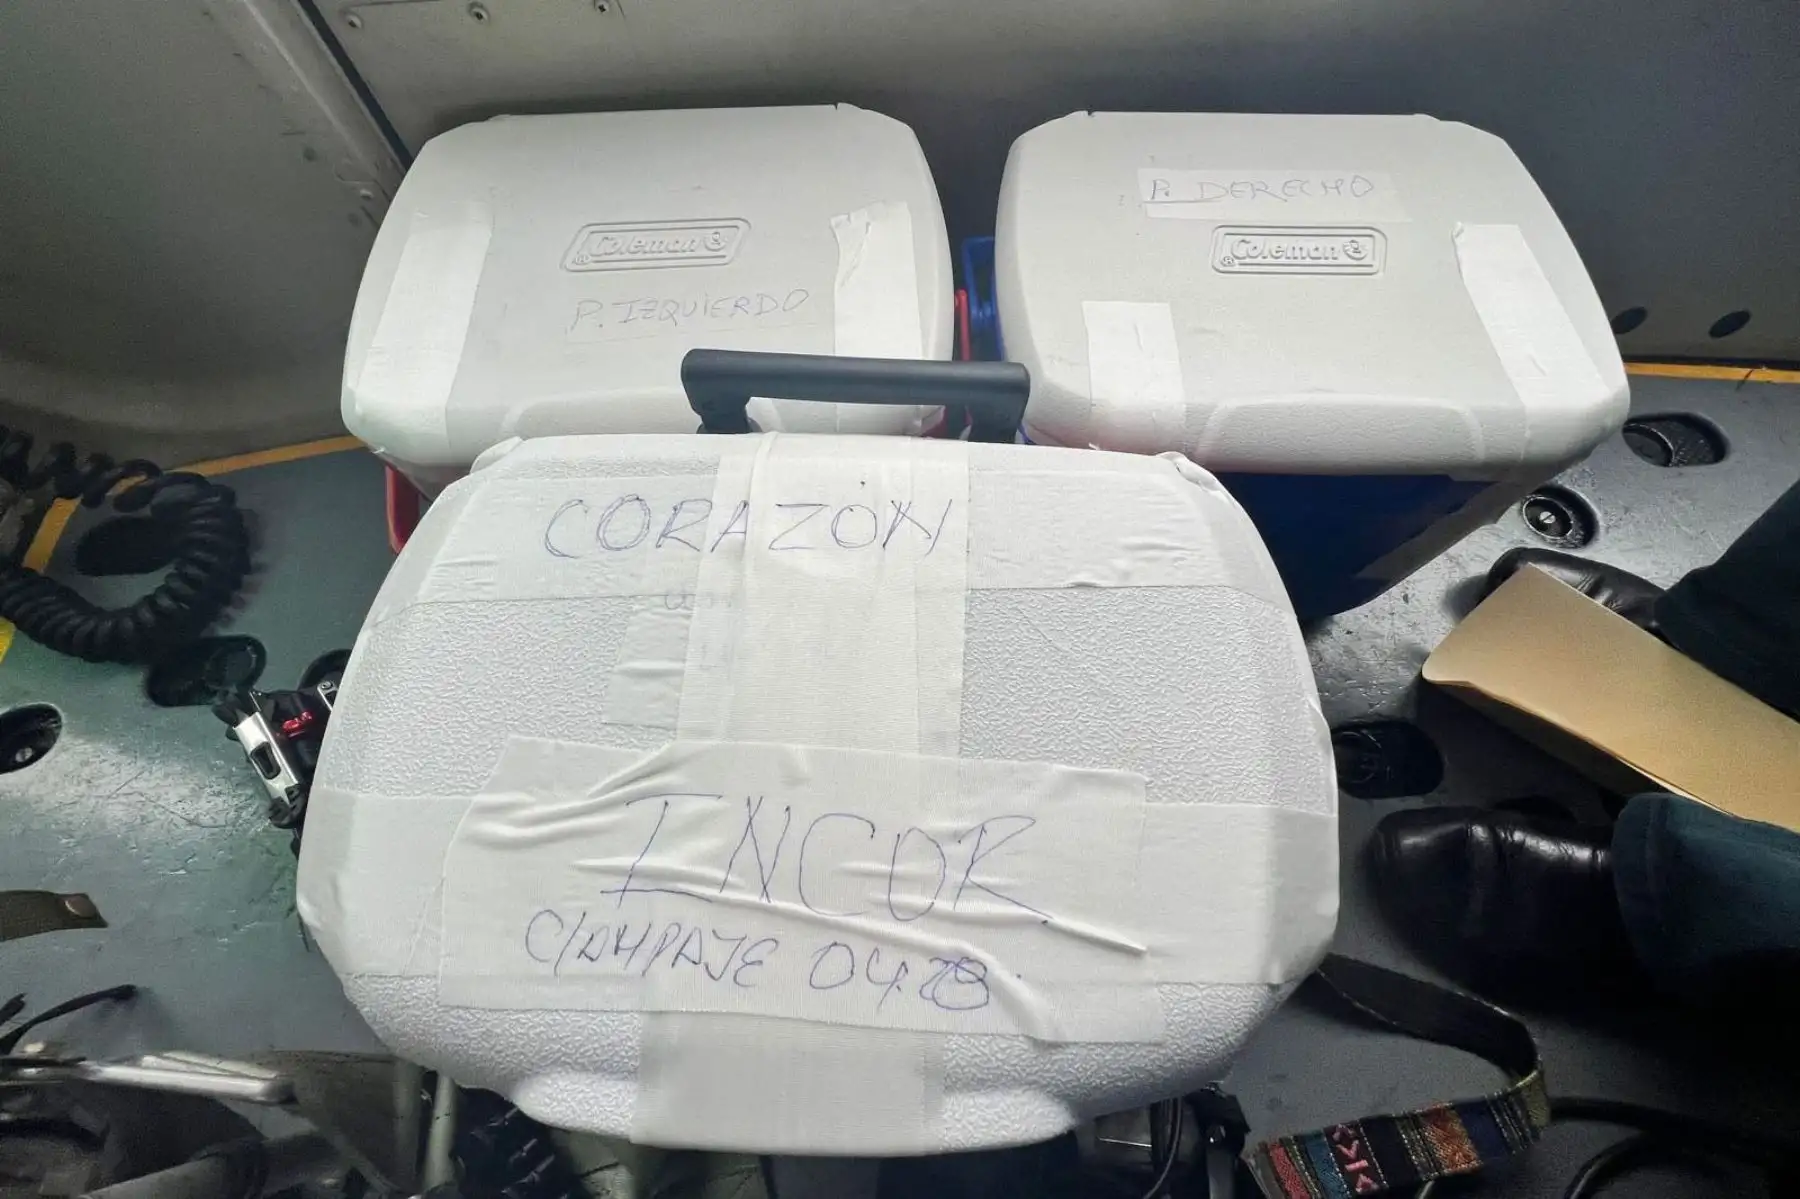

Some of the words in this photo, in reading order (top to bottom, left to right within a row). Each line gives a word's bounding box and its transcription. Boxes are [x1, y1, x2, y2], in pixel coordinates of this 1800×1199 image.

[1197, 174, 1375, 204] DERECHO
[589, 233, 698, 257] Coleman
[1229, 238, 1340, 261] Coleman
[611, 289, 810, 327] IZQUIERDO
